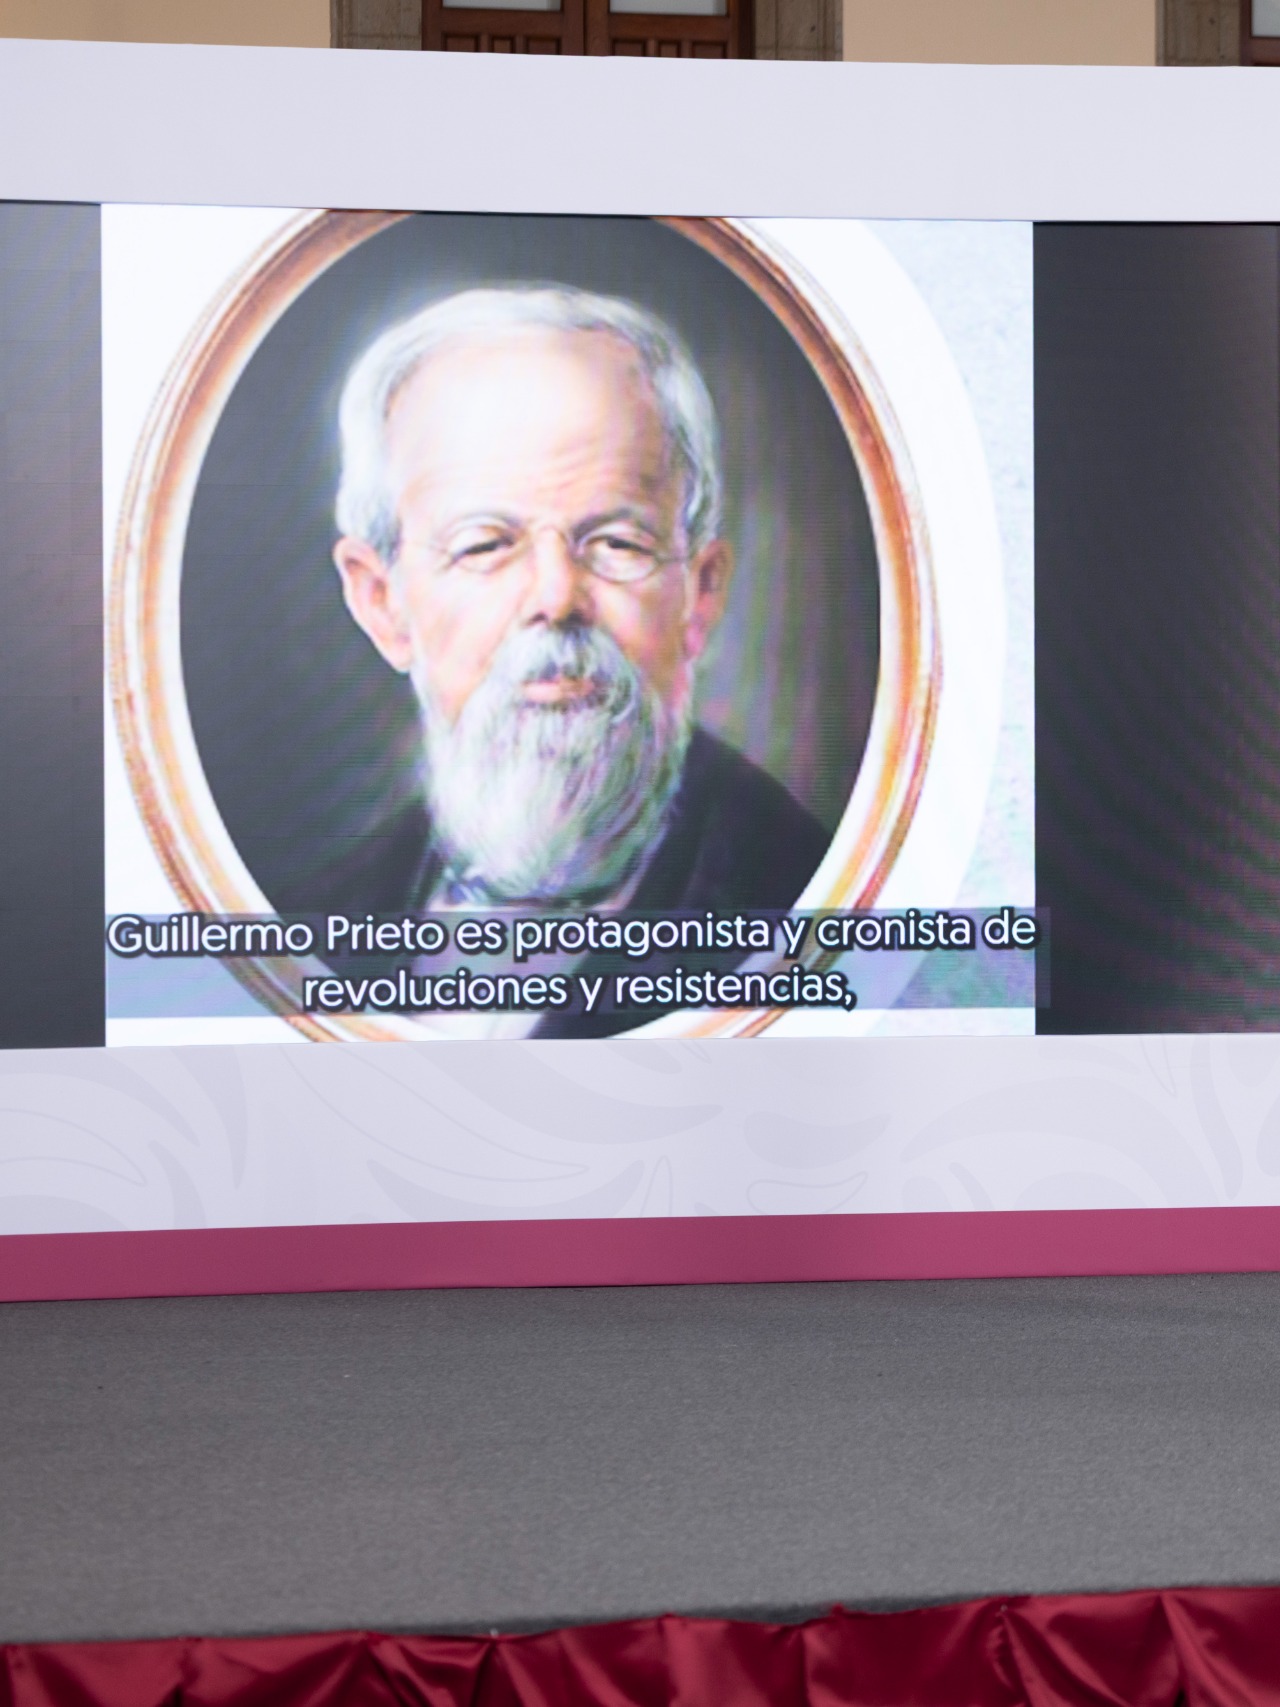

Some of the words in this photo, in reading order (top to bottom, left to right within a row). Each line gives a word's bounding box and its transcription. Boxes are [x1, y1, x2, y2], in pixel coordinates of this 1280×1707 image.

[109, 914, 314, 953] Guillermo
[326, 914, 445, 951] Prieto
[457, 922, 503, 951] es
[516, 912, 770, 959] protagonista
[784, 920, 807, 956] y
[818, 910, 972, 948] cronista
[984, 909, 1037, 946] de
[305, 970, 568, 1007] revoluciones
[580, 977, 604, 1012] y
[616, 967, 855, 1007] resistencias,
